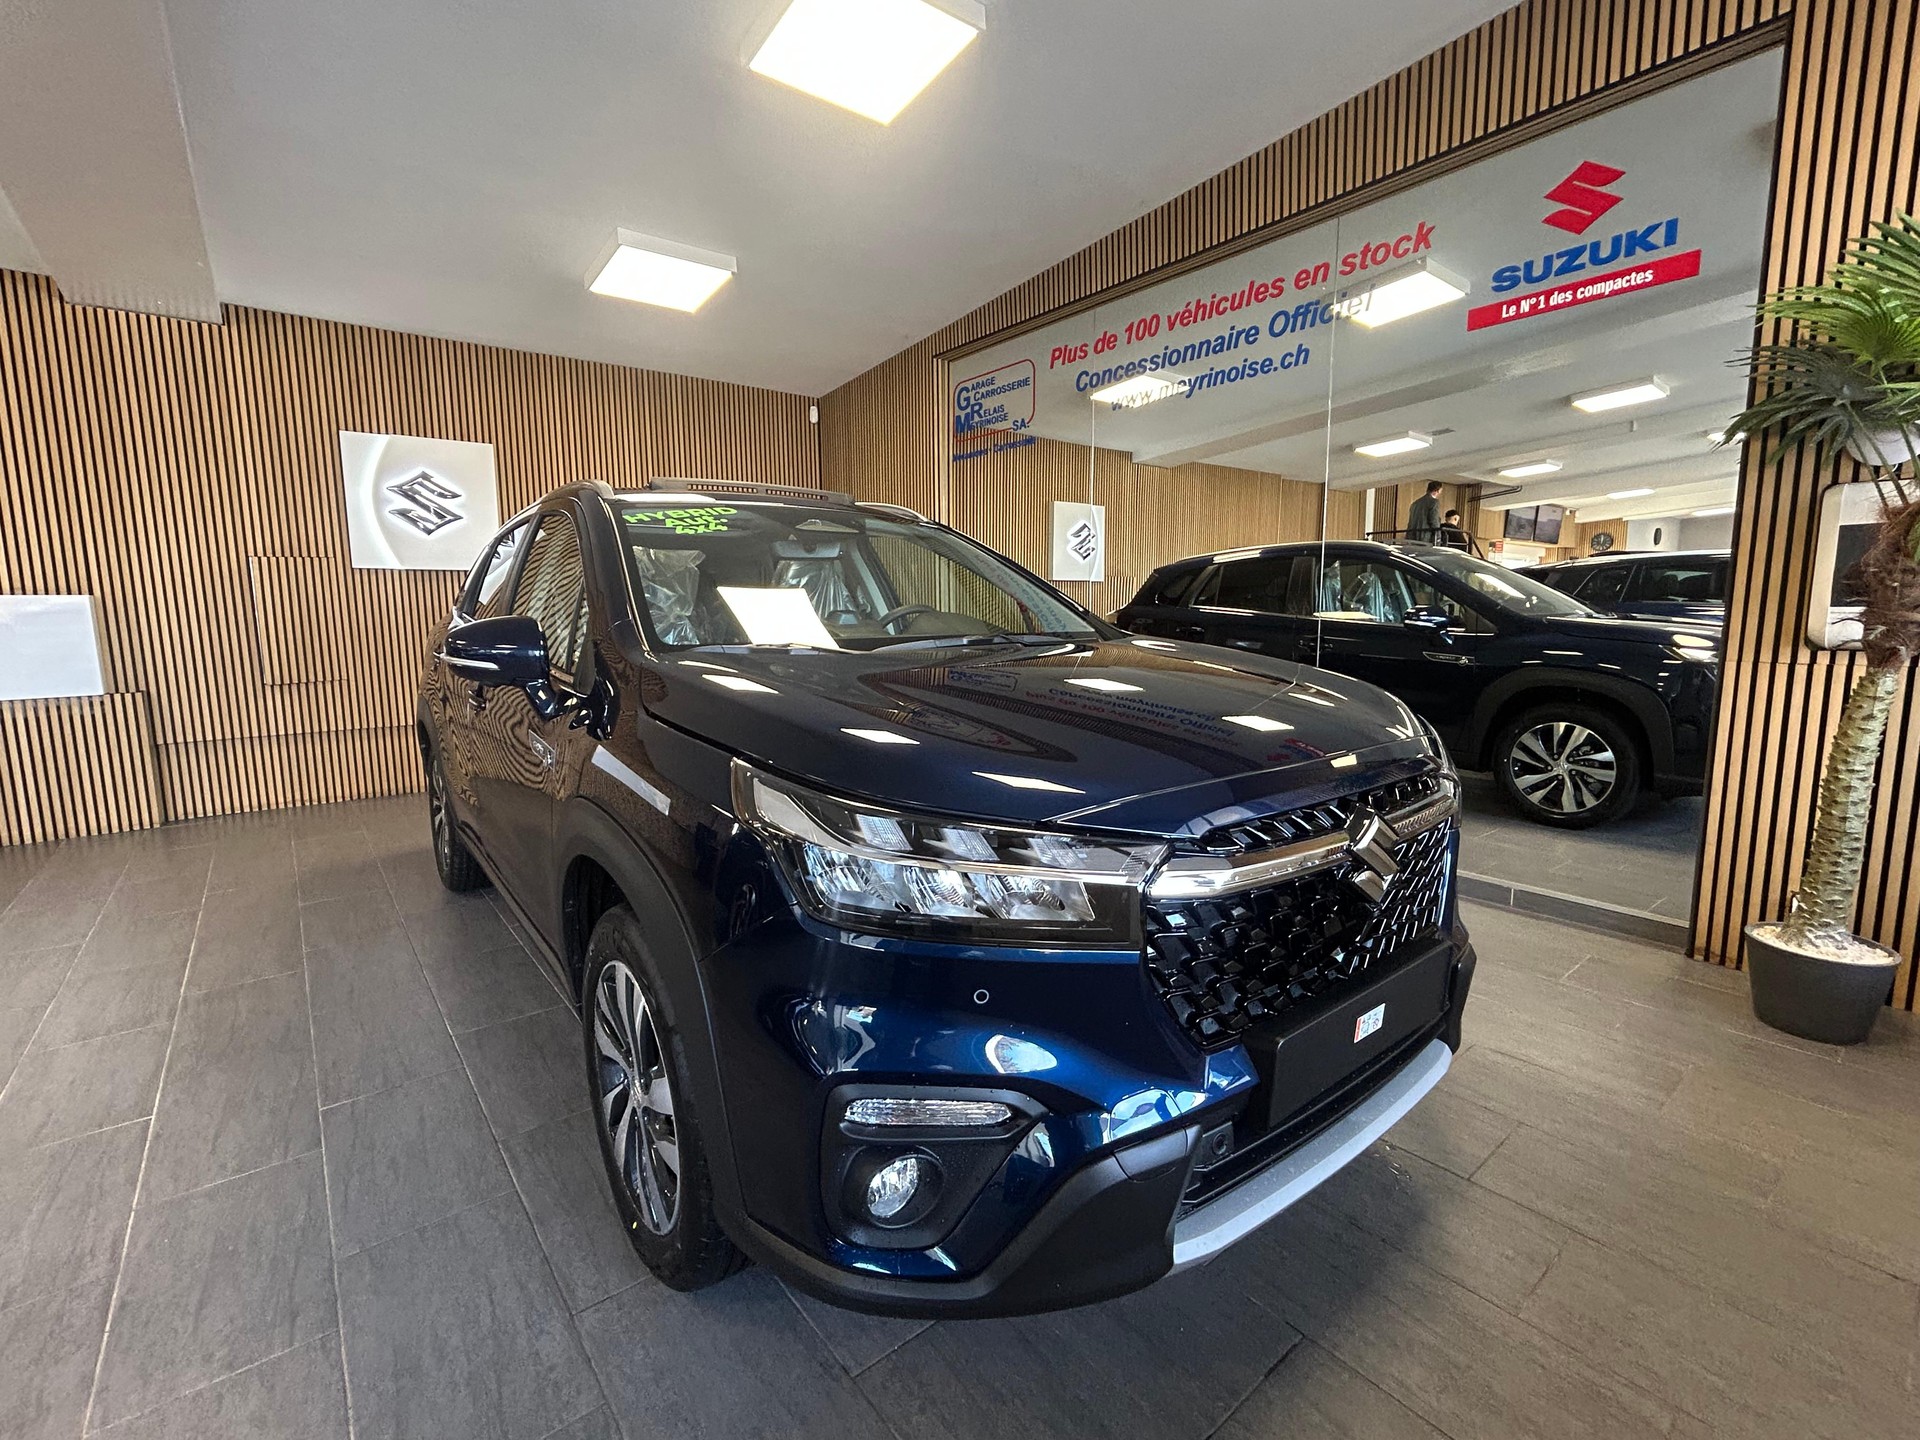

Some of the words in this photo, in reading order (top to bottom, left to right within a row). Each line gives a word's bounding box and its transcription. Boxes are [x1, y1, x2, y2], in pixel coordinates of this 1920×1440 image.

[1491, 217, 1679, 292] SUZUKI
[1050, 343, 1089, 369] Plus
[1093, 331, 1118, 355] de
[1124, 313, 1161, 345] 100
[1166, 277, 1285, 332] véhicules
[1293, 261, 1330, 290] en
[1338, 221, 1436, 276] stock
[1501, 303, 1517, 318] Le
[1519, 294, 1546, 314] N°1
[1549, 287, 1573, 306] des
[1576, 269, 1654, 298] compactes
[1075, 325, 1260, 392] Concessionnaire
[1268, 282, 1377, 338] Officiel
[973, 376, 1031, 402] CARROSSERIE
[622, 507, 738, 523] HYBRID
